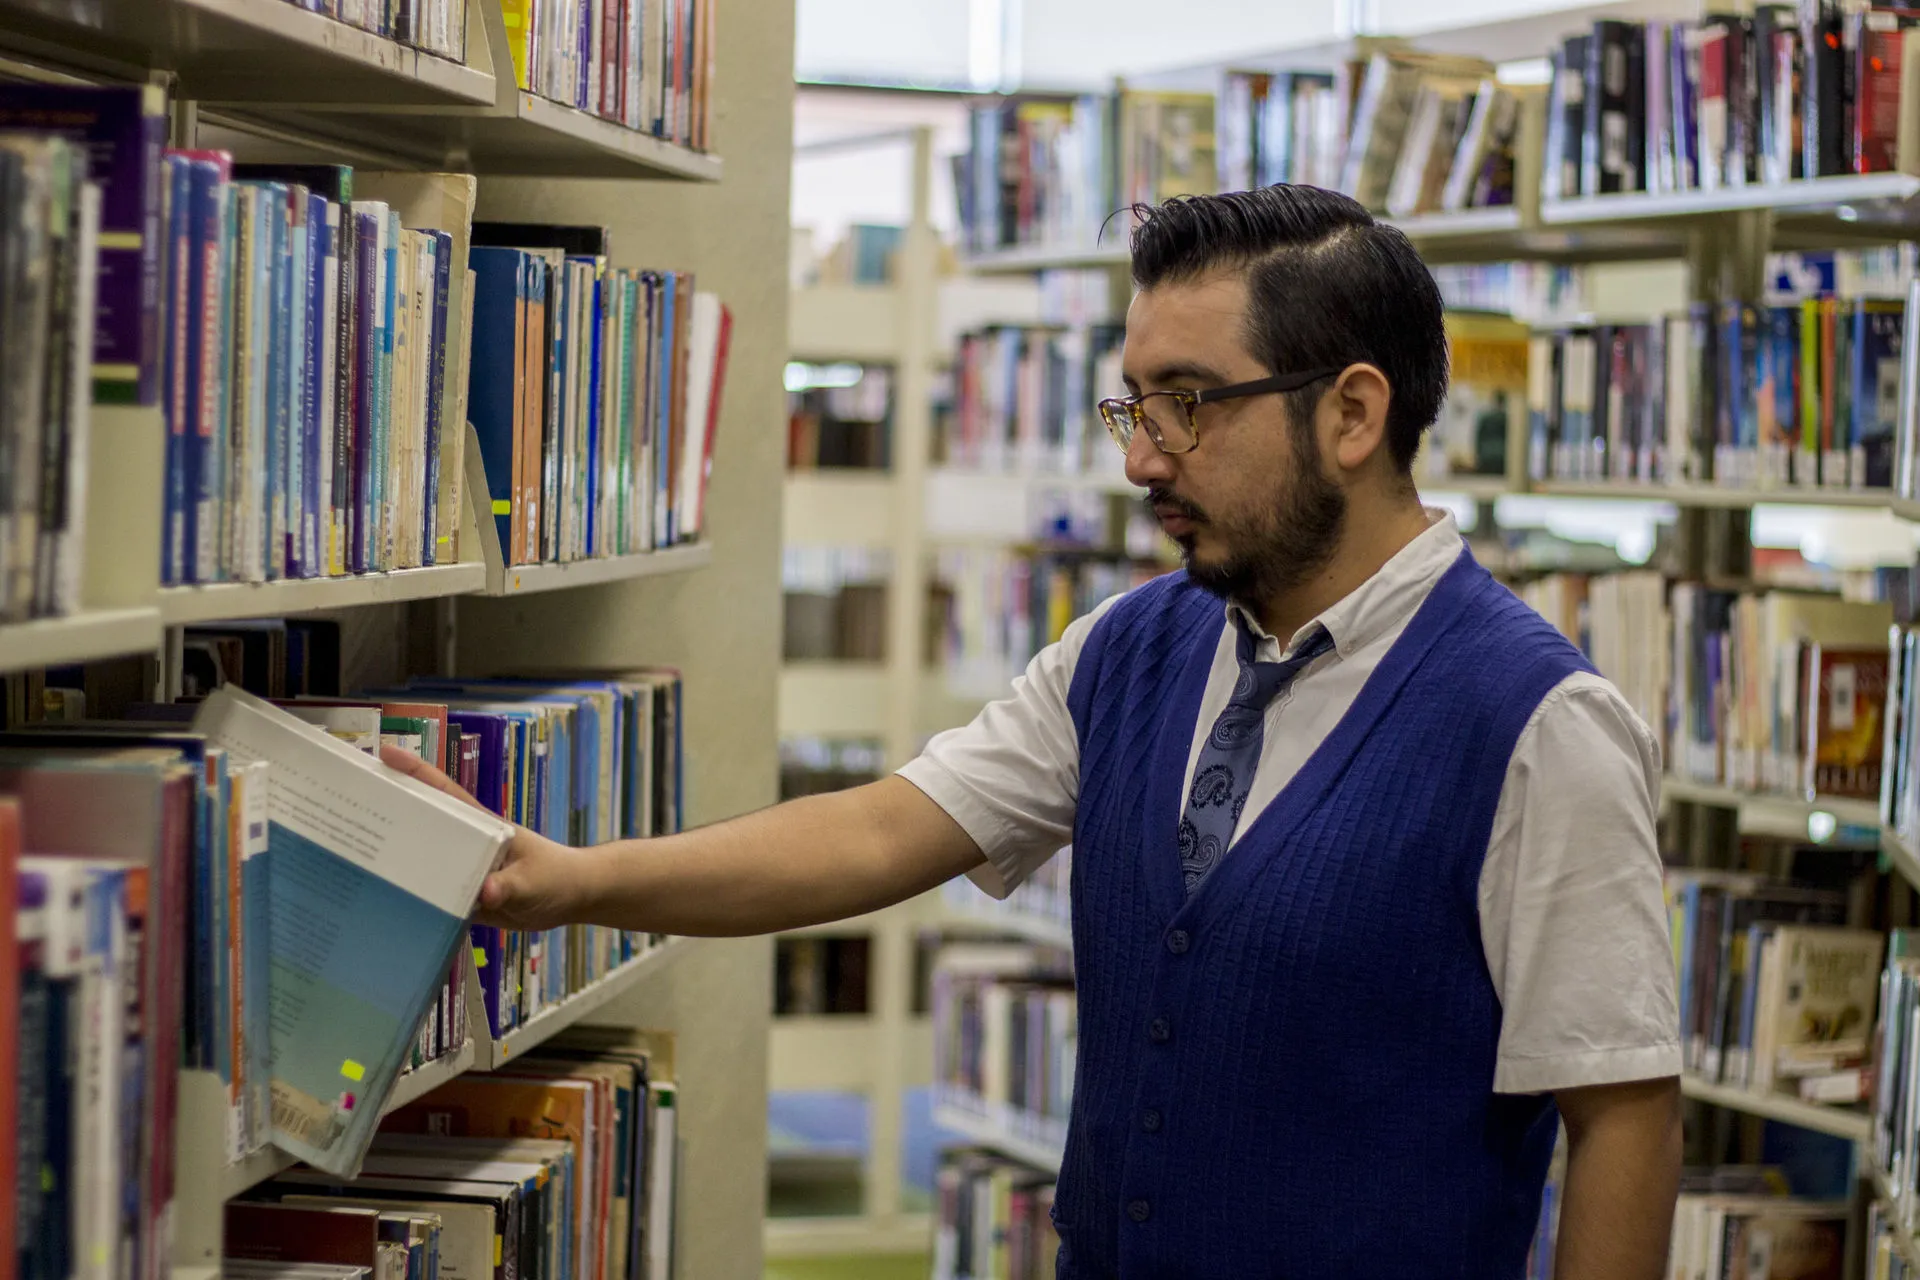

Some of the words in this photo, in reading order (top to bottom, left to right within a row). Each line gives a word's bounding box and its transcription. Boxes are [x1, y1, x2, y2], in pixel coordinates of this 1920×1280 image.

[308, 219, 317, 299] CLOUD
[341, 260, 349, 320] Windows
[203, 247, 217, 430] Multimedia
[305, 304, 315, 436] COMPUTING
[337, 379, 346, 466] Development
